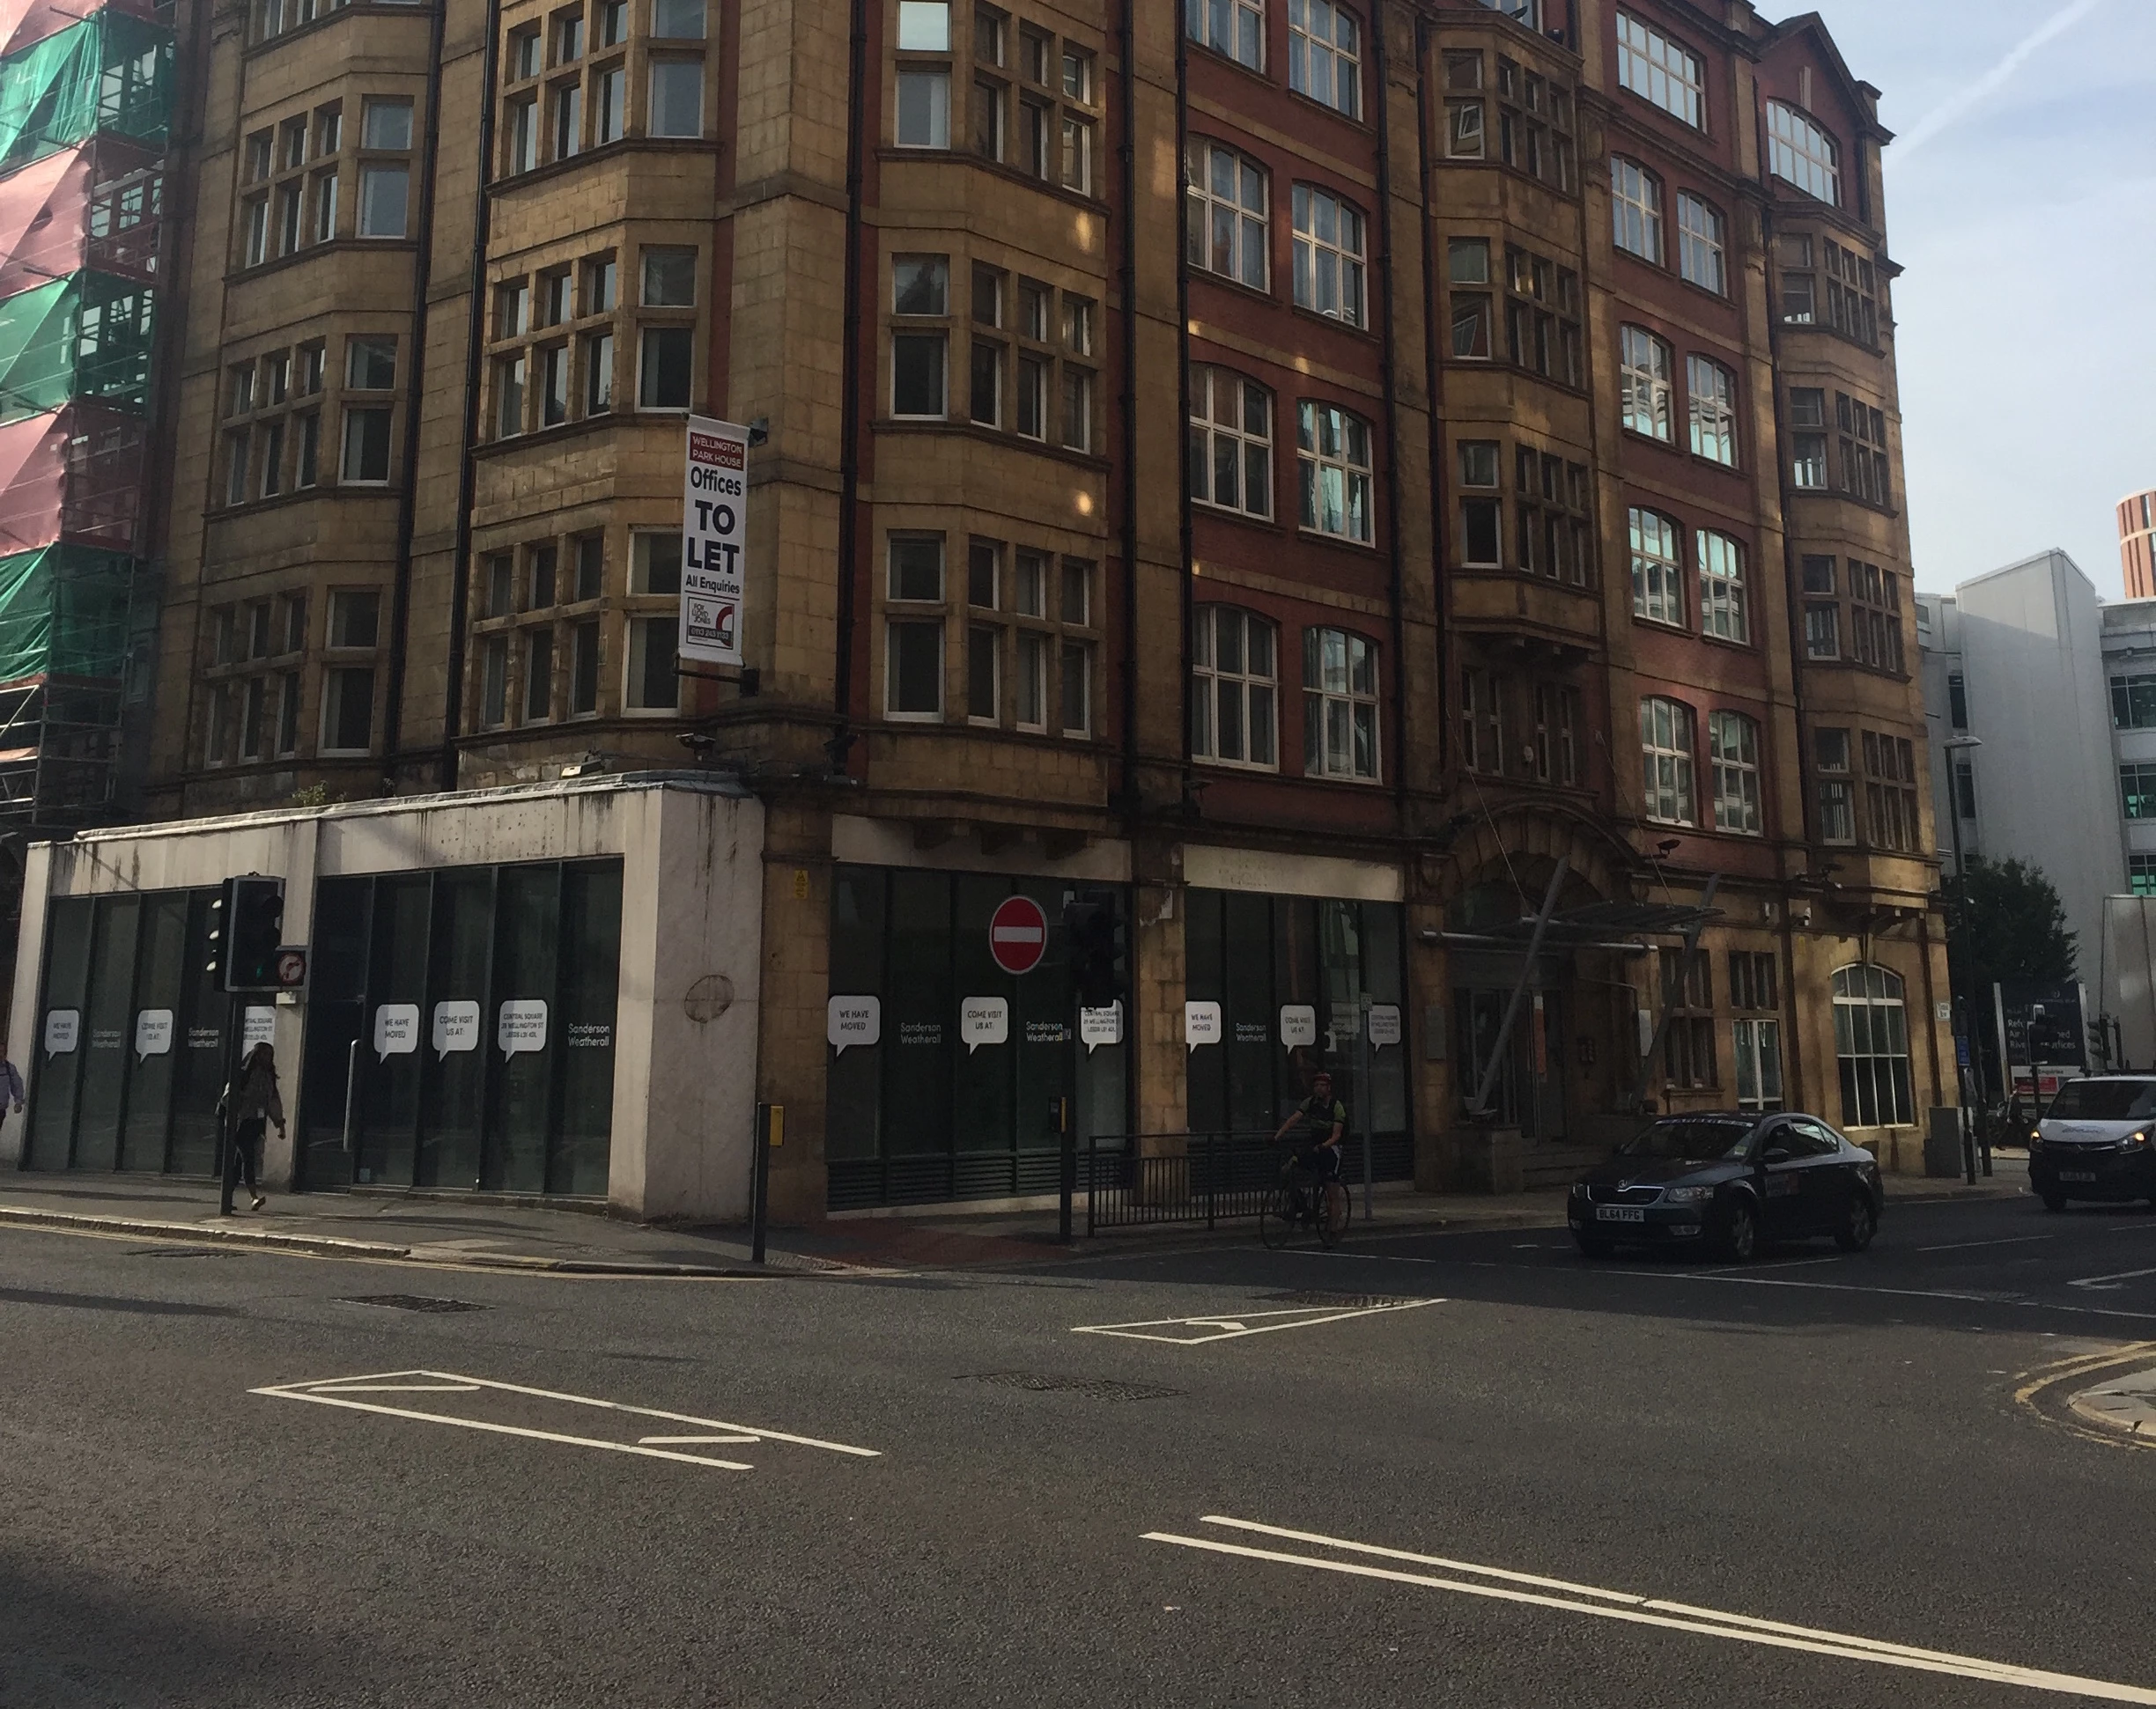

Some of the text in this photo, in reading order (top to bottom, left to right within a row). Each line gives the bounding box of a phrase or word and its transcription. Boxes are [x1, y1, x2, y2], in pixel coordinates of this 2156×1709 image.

[692, 436, 742, 454] WELLINGTON
[692, 449, 742, 468] PARK HOUSE
[690, 466, 742, 497] Offices
[695, 499, 735, 535] TO
[688, 536, 740, 574] LET
[686, 574, 740, 594] All Enquiries
[458, 1015, 474, 1024] VISIT
[839, 1010, 869, 1019] WE HAVE
[968, 1010, 1002, 1019] COME VISIT
[1200, 1013, 1213, 1021] HAVE
[385, 1018, 410, 1027] WE HAVE
[840, 1021, 867, 1031] MOVED
[900, 1022, 941, 1033] Sanderson
[975, 1021, 984, 1030] US
[1025, 1021, 1063, 1031] Sanderson
[1236, 1022, 1266, 1032] Sanderson
[446, 1028, 454, 1036] US
[568, 1022, 610, 1034] Sanderson
[568, 1035, 610, 1047] Weatherall
[900, 1034, 941, 1044] Weatherall
[1026, 1033, 1064, 1042] Weatherall
[1236, 1033, 1267, 1042] Weatherall
[1599, 1209, 1640, 1220] BL64 FFG
